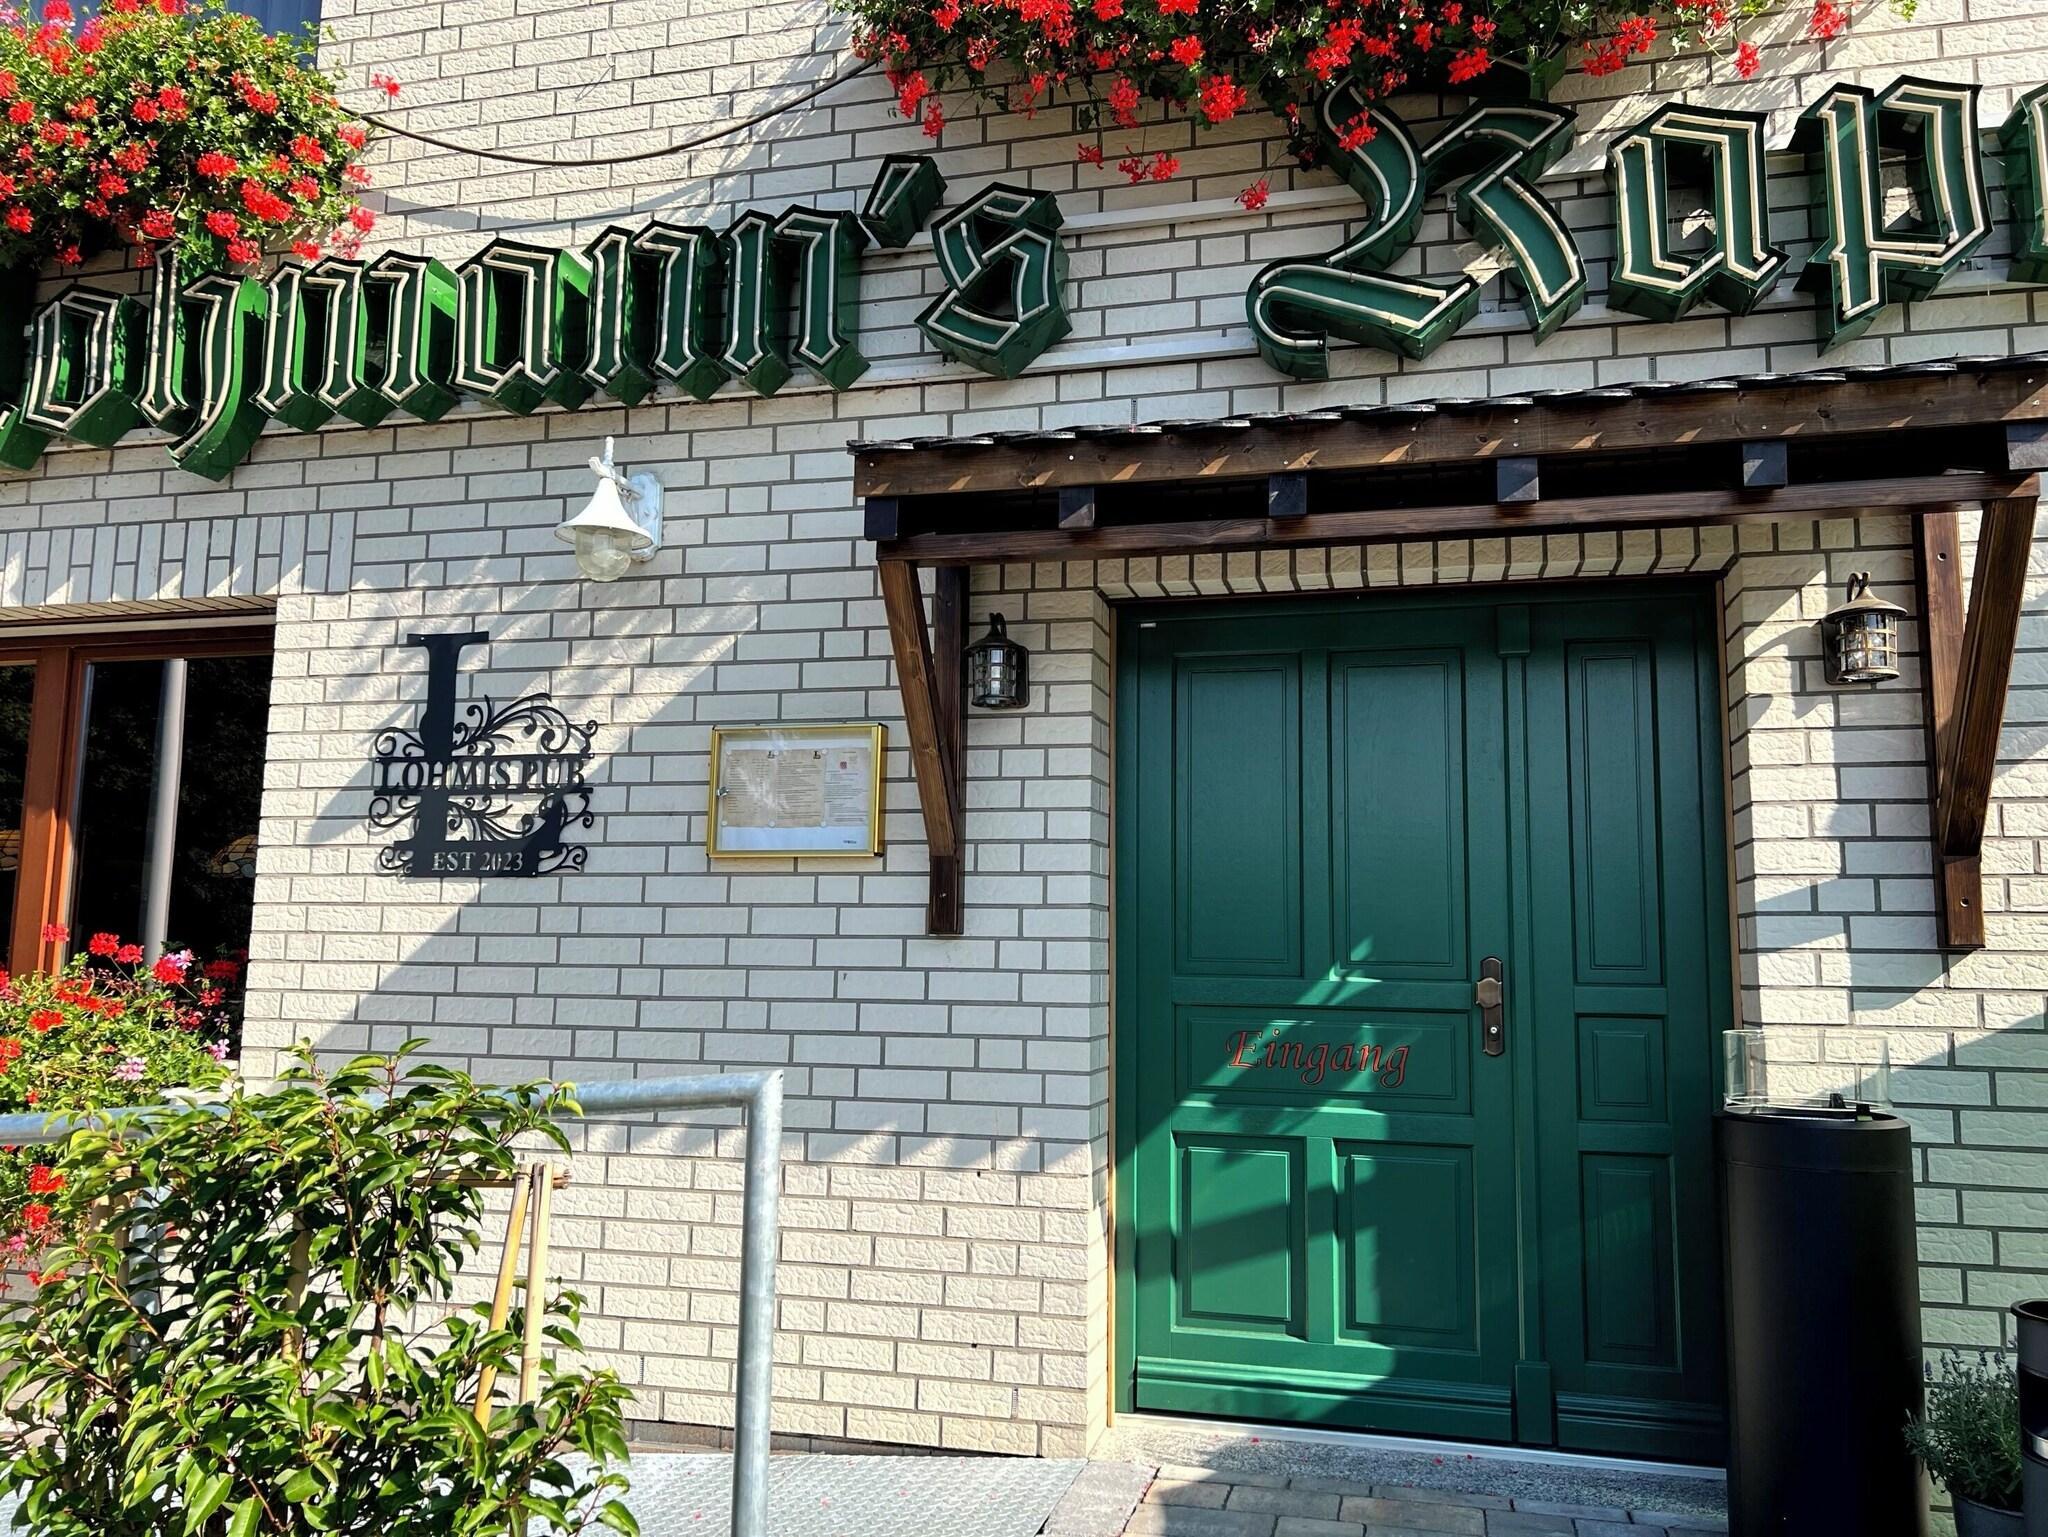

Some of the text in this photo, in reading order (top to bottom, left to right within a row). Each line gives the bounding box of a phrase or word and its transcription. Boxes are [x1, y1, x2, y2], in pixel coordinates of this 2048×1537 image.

[0, 154, 1072, 480] ohmann's
[431, 851, 523, 871] EST 2023
[1225, 1027, 1411, 1089] Eingang
